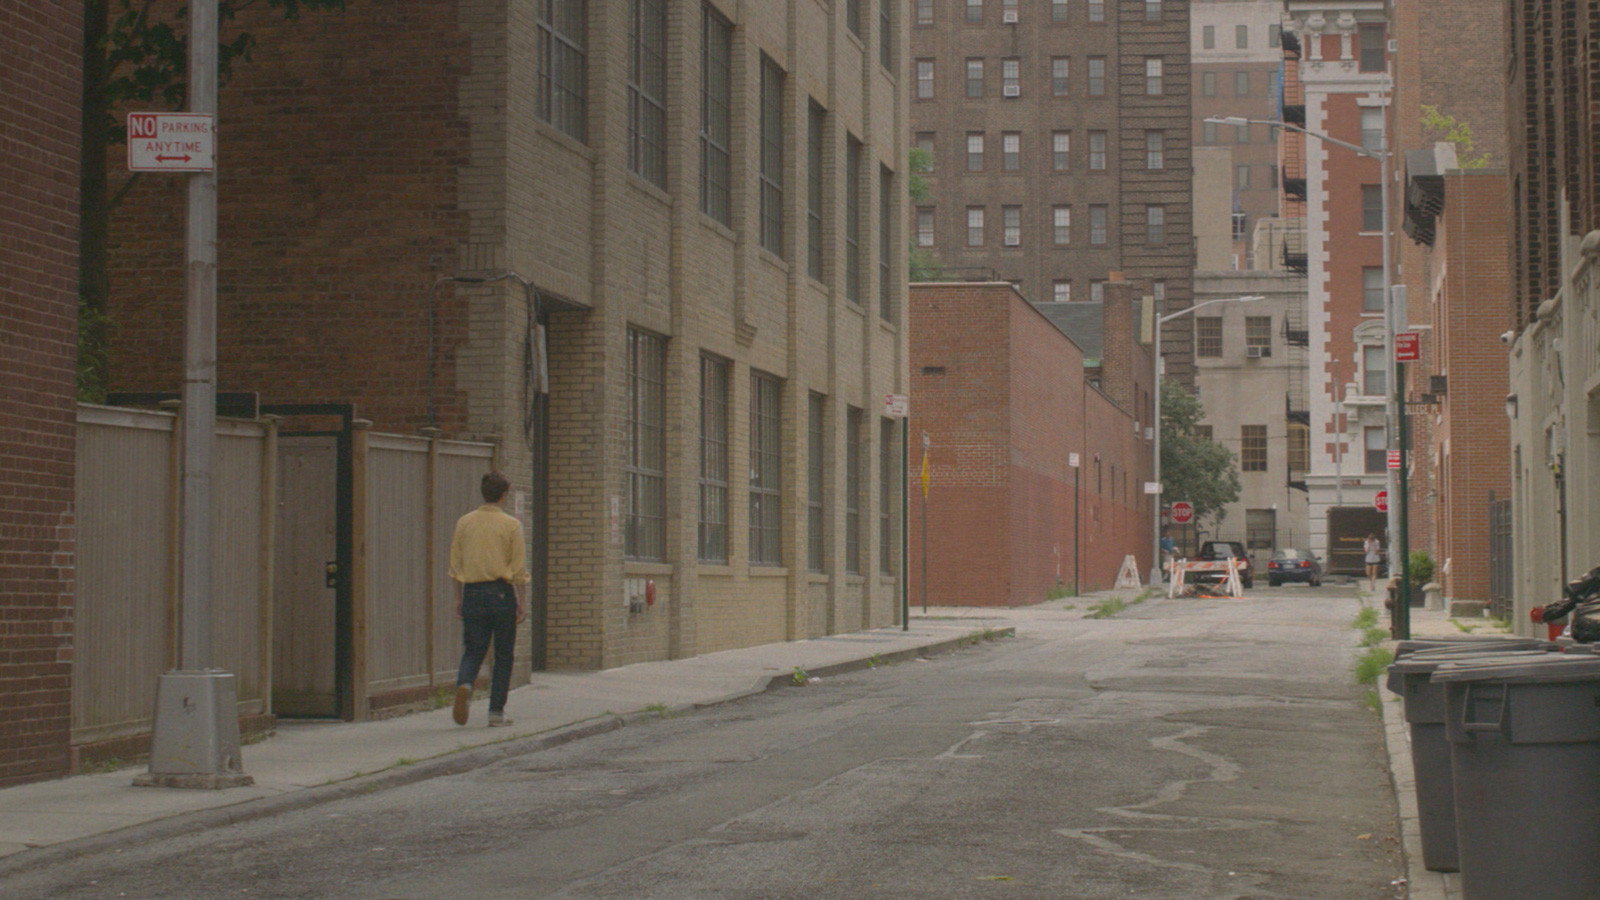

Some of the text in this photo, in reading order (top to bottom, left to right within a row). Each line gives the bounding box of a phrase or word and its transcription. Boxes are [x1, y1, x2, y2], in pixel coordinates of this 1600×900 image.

[131, 116, 208, 136] NO PARKING
[145, 141, 202, 153] ANYTIME
[1172, 508, 1193, 517] STOP
